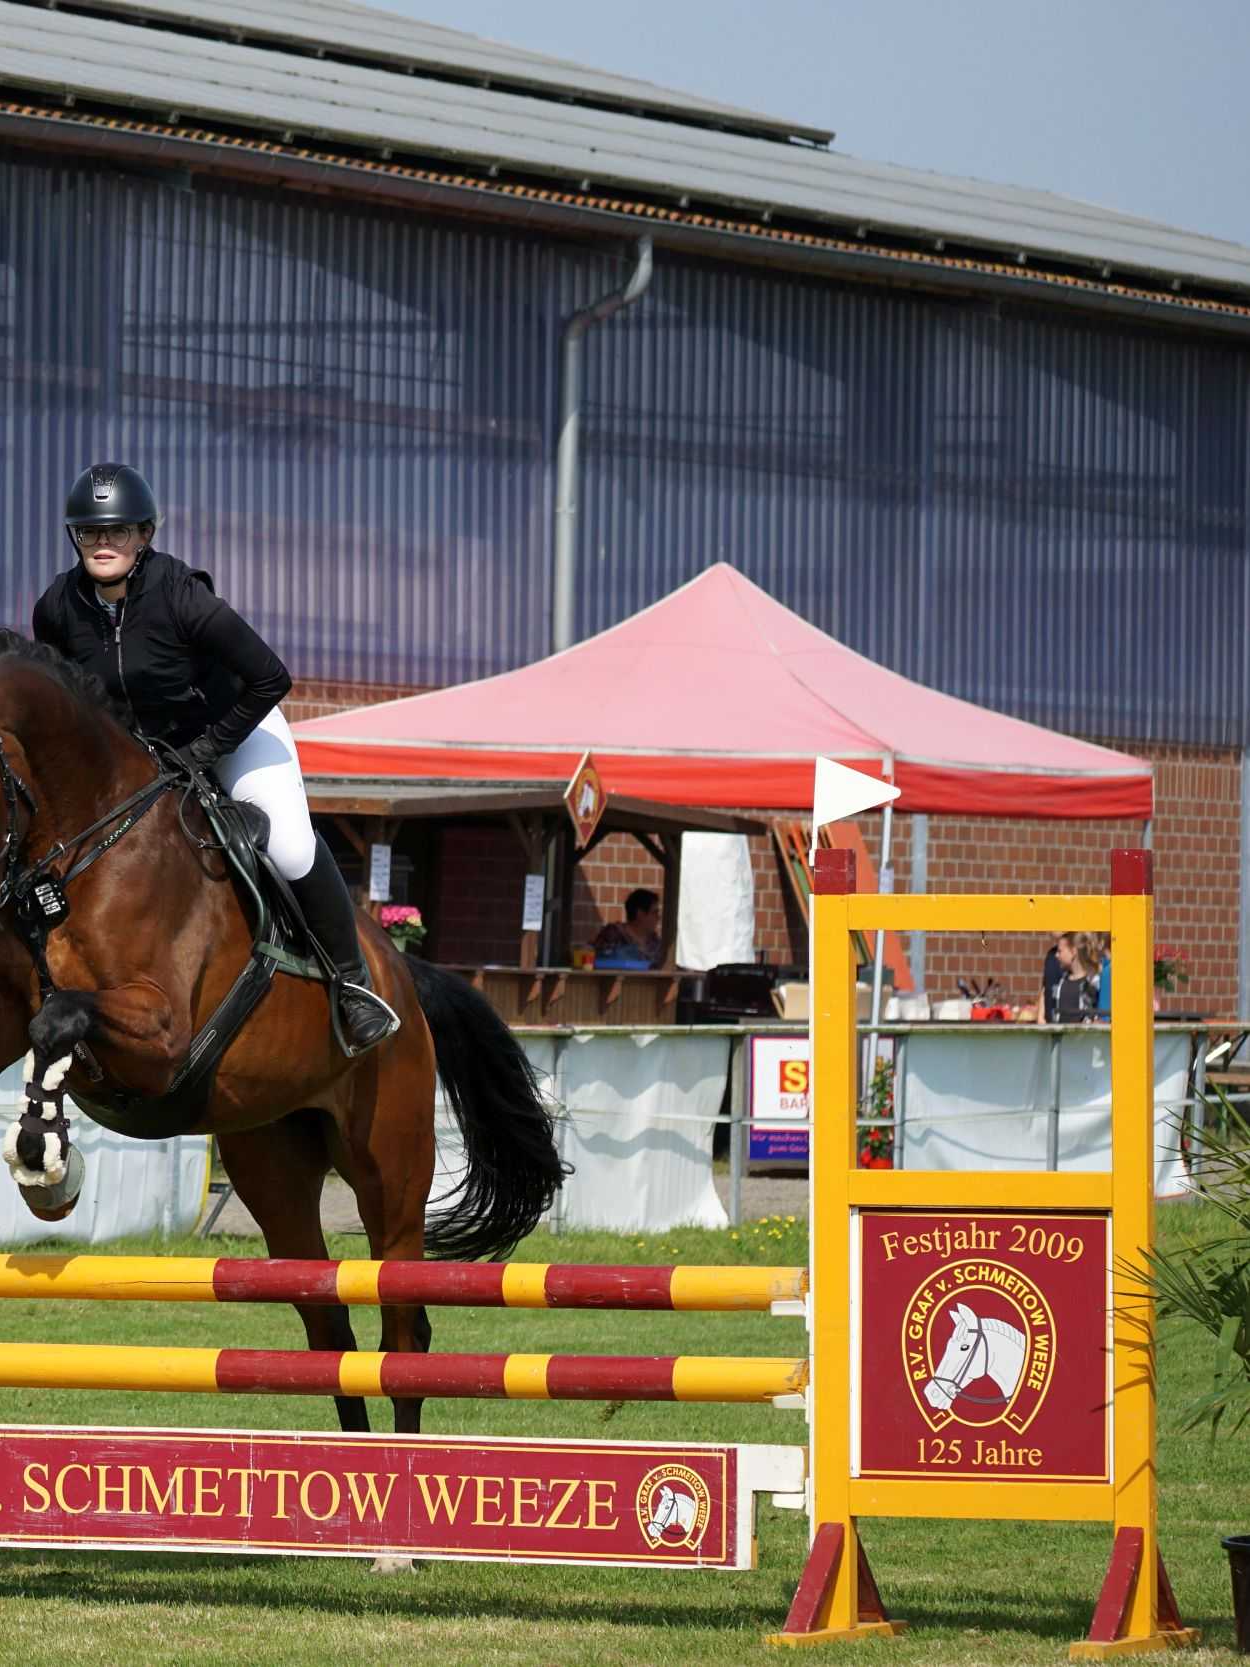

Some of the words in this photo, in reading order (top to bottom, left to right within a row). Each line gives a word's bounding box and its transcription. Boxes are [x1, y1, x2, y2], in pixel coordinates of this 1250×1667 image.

[880, 1221, 1001, 1262] Festjahr
[1008, 1224, 1084, 1263] 2009
[908, 1289, 936, 1340] GRAF
[935, 1279, 952, 1292] v.
[953, 1265, 1047, 1327] SCHMETTOW
[1026, 1333, 1049, 1391] WEEZE
[917, 1438, 962, 1465] 125
[971, 1439, 1043, 1467] Jahre
[23, 1463, 398, 1522] SCHMETTOW
[414, 1474, 620, 1531] WEEZE
[661, 1467, 706, 1498] SCHMETTOW
